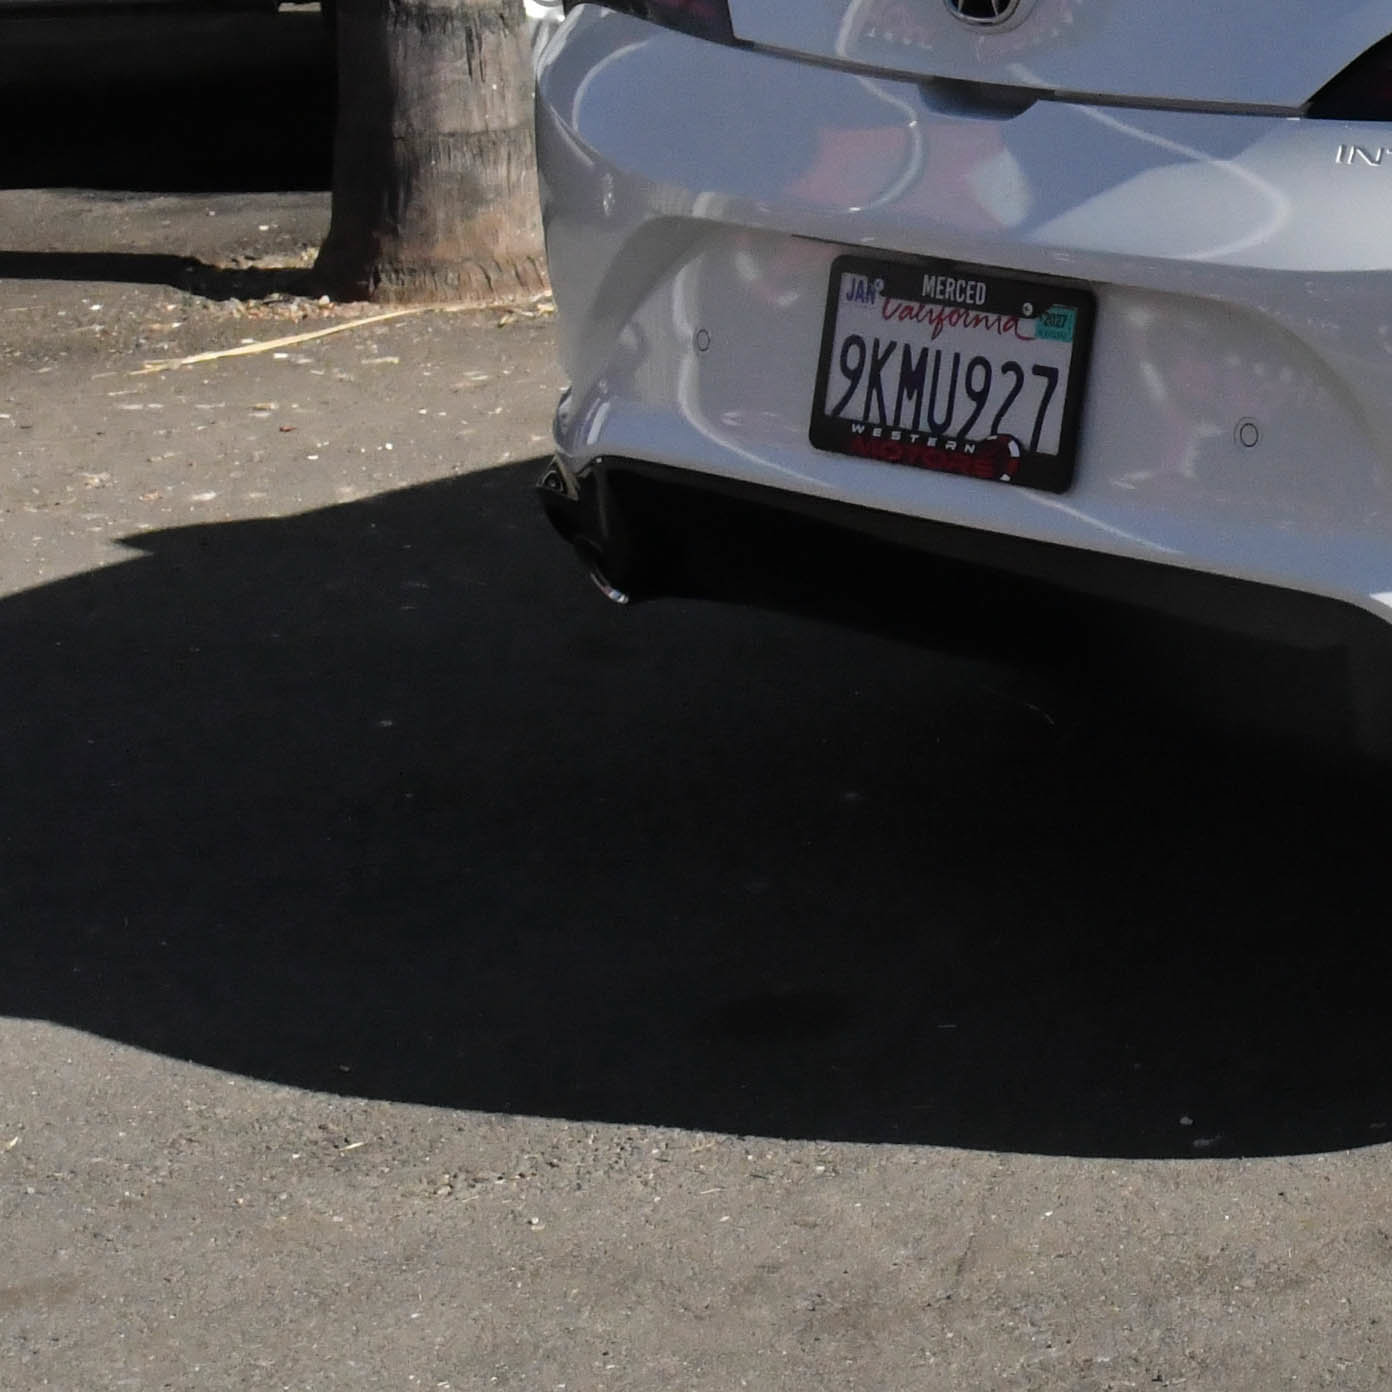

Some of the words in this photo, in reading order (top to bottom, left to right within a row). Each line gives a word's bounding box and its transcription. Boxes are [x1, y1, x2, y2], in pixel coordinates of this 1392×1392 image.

[846, 277, 875, 305] JAN
[922, 274, 986, 305] MERCED
[830, 334, 1059, 453] 9KMU927
[851, 423, 976, 454] WESTERN
